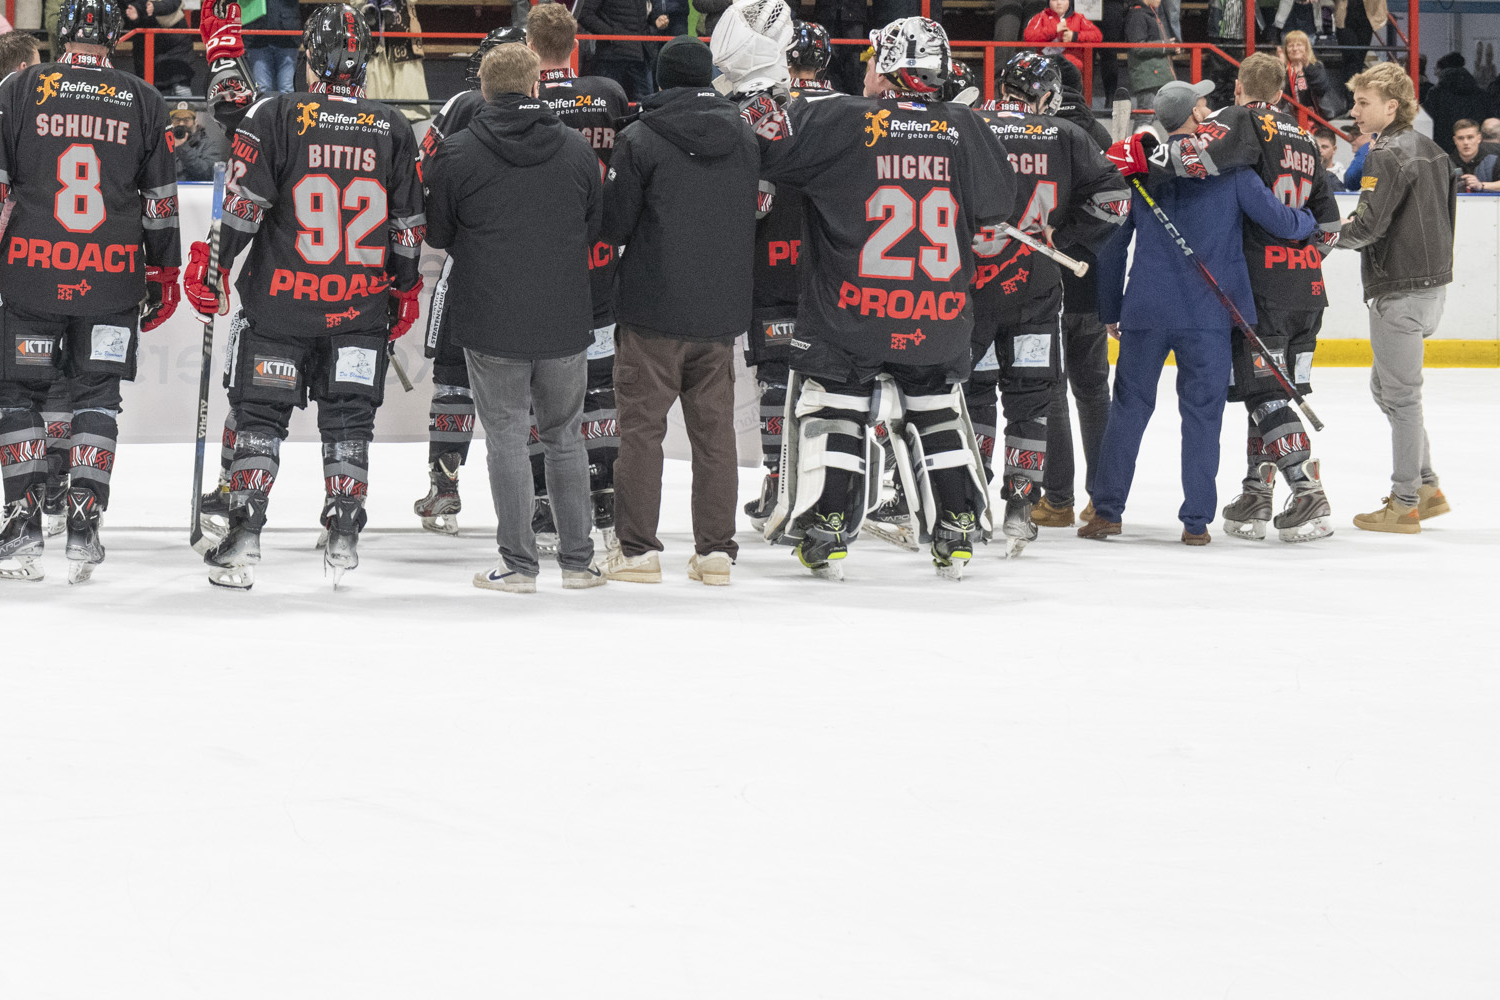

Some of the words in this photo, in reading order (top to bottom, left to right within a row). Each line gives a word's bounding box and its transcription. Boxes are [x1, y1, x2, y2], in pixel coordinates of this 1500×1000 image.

[547, 71, 565, 80] 1996
[59, 91, 73, 100] Wir
[75, 93, 100, 102] geben
[60, 80, 134, 102] Reifen24.de
[332, 85, 351, 95] 1996
[1001, 103, 1019, 111] 1996
[36, 112, 130, 145] SCHULTE
[319, 111, 391, 131] Reifen24.de
[319, 121, 332, 130] Wir
[334, 123, 360, 133] geben
[890, 118, 960, 141] Reifen24.de
[989, 124, 1059, 136] Reifen24.de
[890, 131, 905, 140] Wir
[907, 132, 934, 141] geben
[1004, 133, 1029, 141] geben
[308, 143, 377, 173] BITTIS
[876, 154, 952, 182] NICKEL
[1279, 143, 1316, 177] JÄGER
[53, 142, 107, 234] 8
[291, 172, 389, 268] 92
[858, 184, 963, 283] 29
[1153, 206, 1194, 257] CCM
[7, 236, 139, 273] PROACT
[262, 360, 297, 378] KTM
[197, 398, 209, 439] ALPHA
